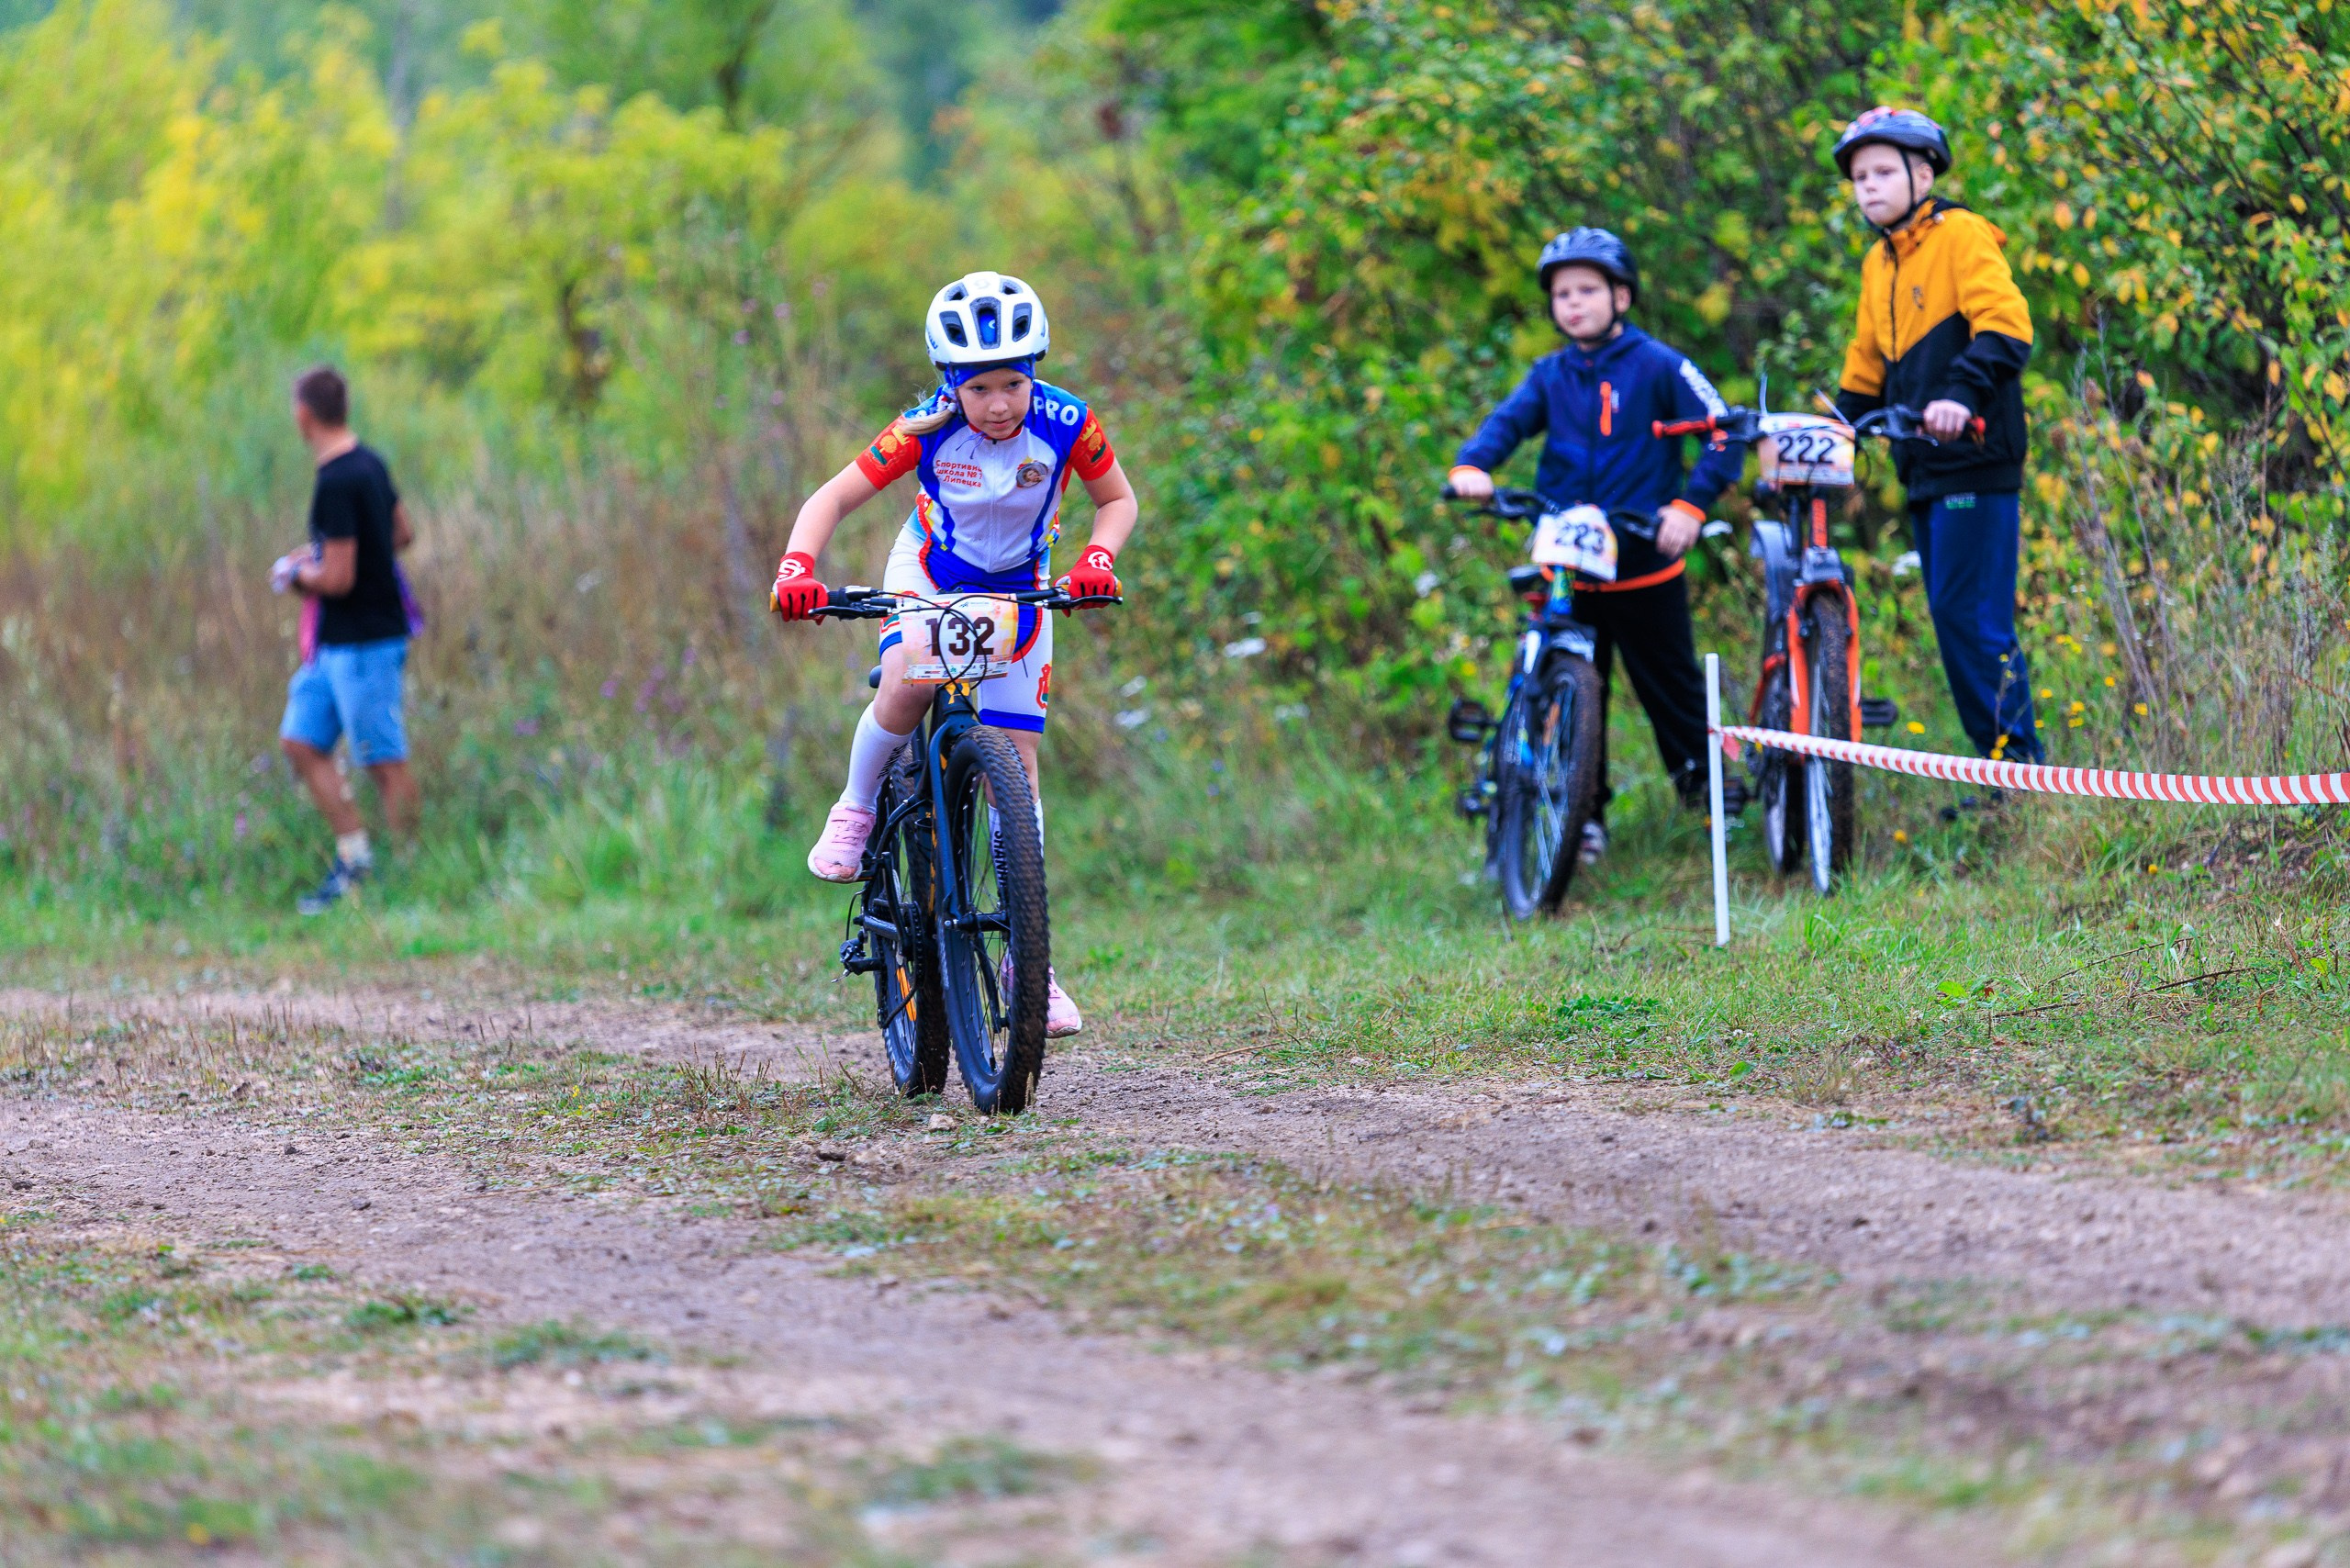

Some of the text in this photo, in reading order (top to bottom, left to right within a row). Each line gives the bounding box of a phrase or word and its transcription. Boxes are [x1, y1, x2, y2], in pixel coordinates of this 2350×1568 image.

[1034, 396, 1080, 426] PRO
[1778, 435, 1833, 464] 222
[944, 475, 982, 488] Липецка
[1555, 520, 1605, 556] 223
[925, 617, 994, 656] 132
